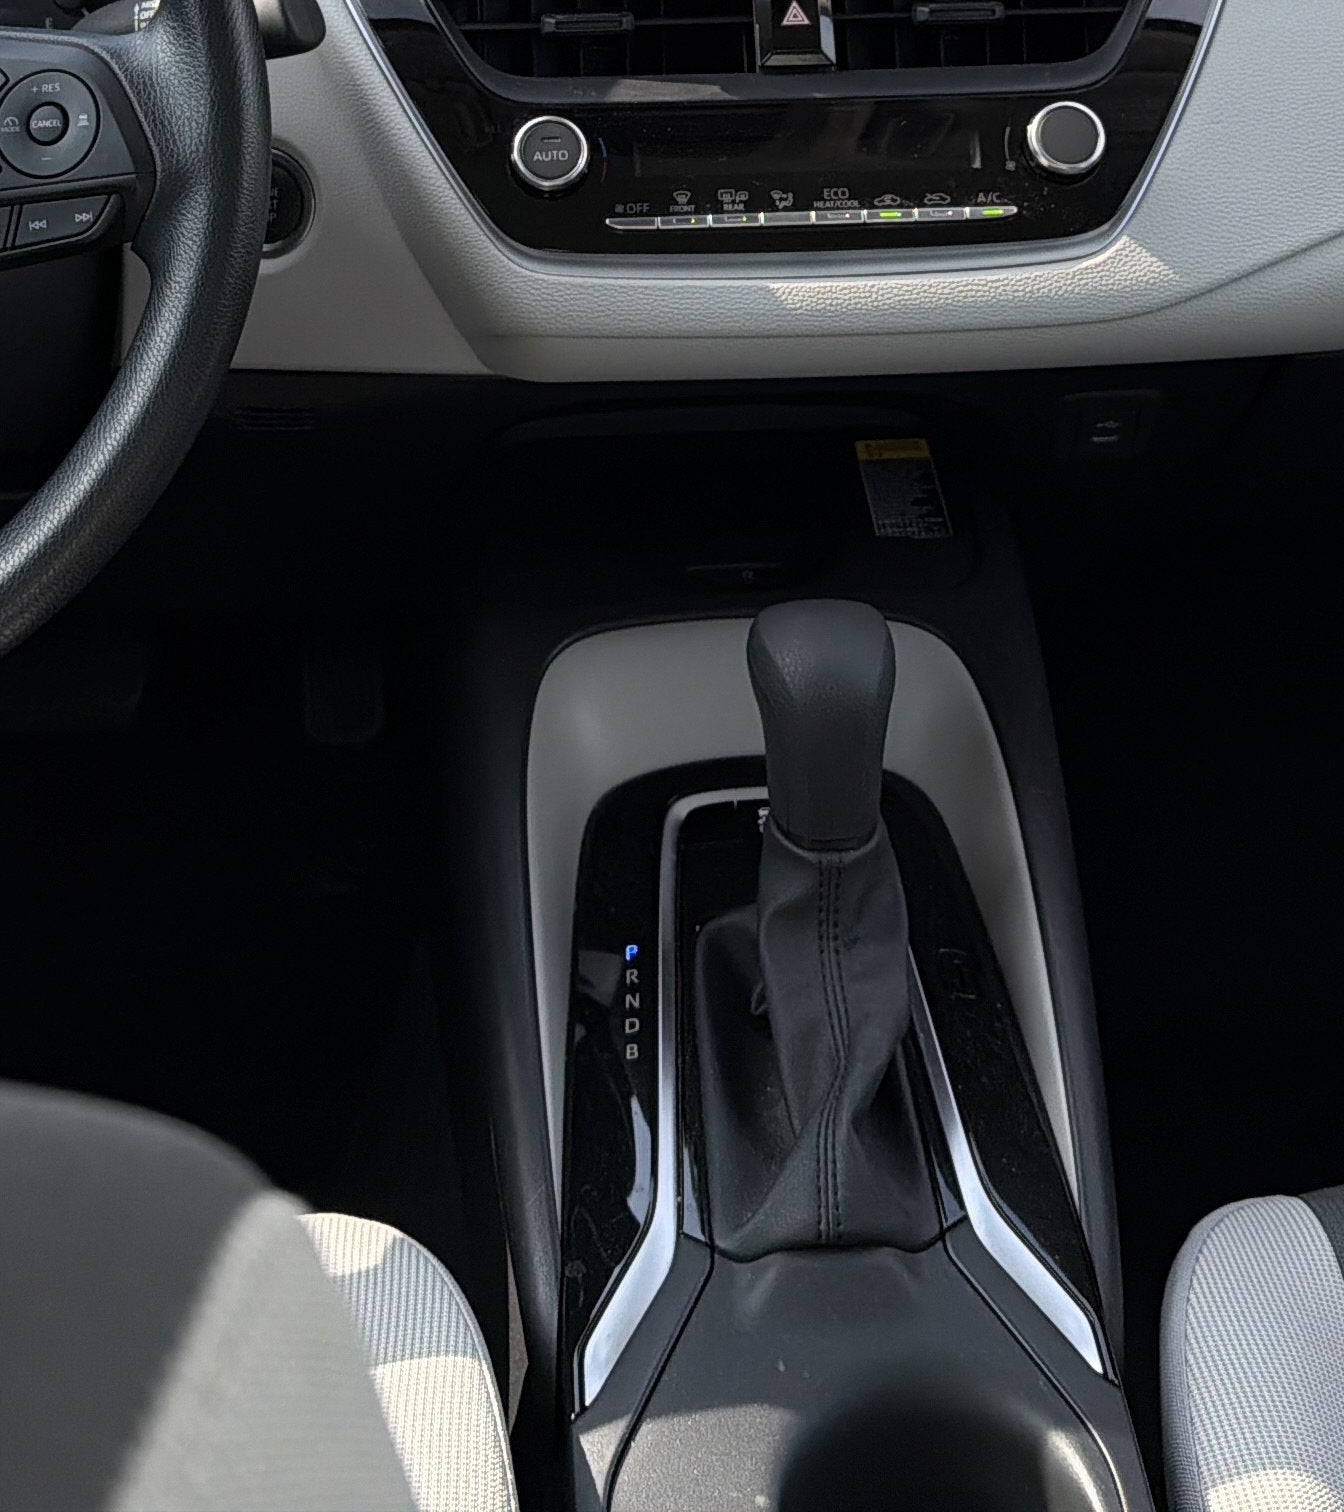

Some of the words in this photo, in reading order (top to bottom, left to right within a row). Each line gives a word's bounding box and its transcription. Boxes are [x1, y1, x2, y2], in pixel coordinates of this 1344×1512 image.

[41, 83, 61, 92] RES
[31, 120, 62, 128] CANCEL
[533, 150, 568, 162] AUTO
[823, 188, 849, 200] ECO
[977, 192, 1001, 203] A/C
[626, 203, 651, 214] OFF
[669, 204, 696, 213] FRONT
[723, 202, 745, 211] REAR
[813, 200, 861, 209] HEAT/COOL
[625, 944, 639, 961] P
[625, 969, 640, 985] R
[625, 992, 640, 1009] N
[625, 1017, 640, 1034] D
[625, 1043, 639, 1060] B
